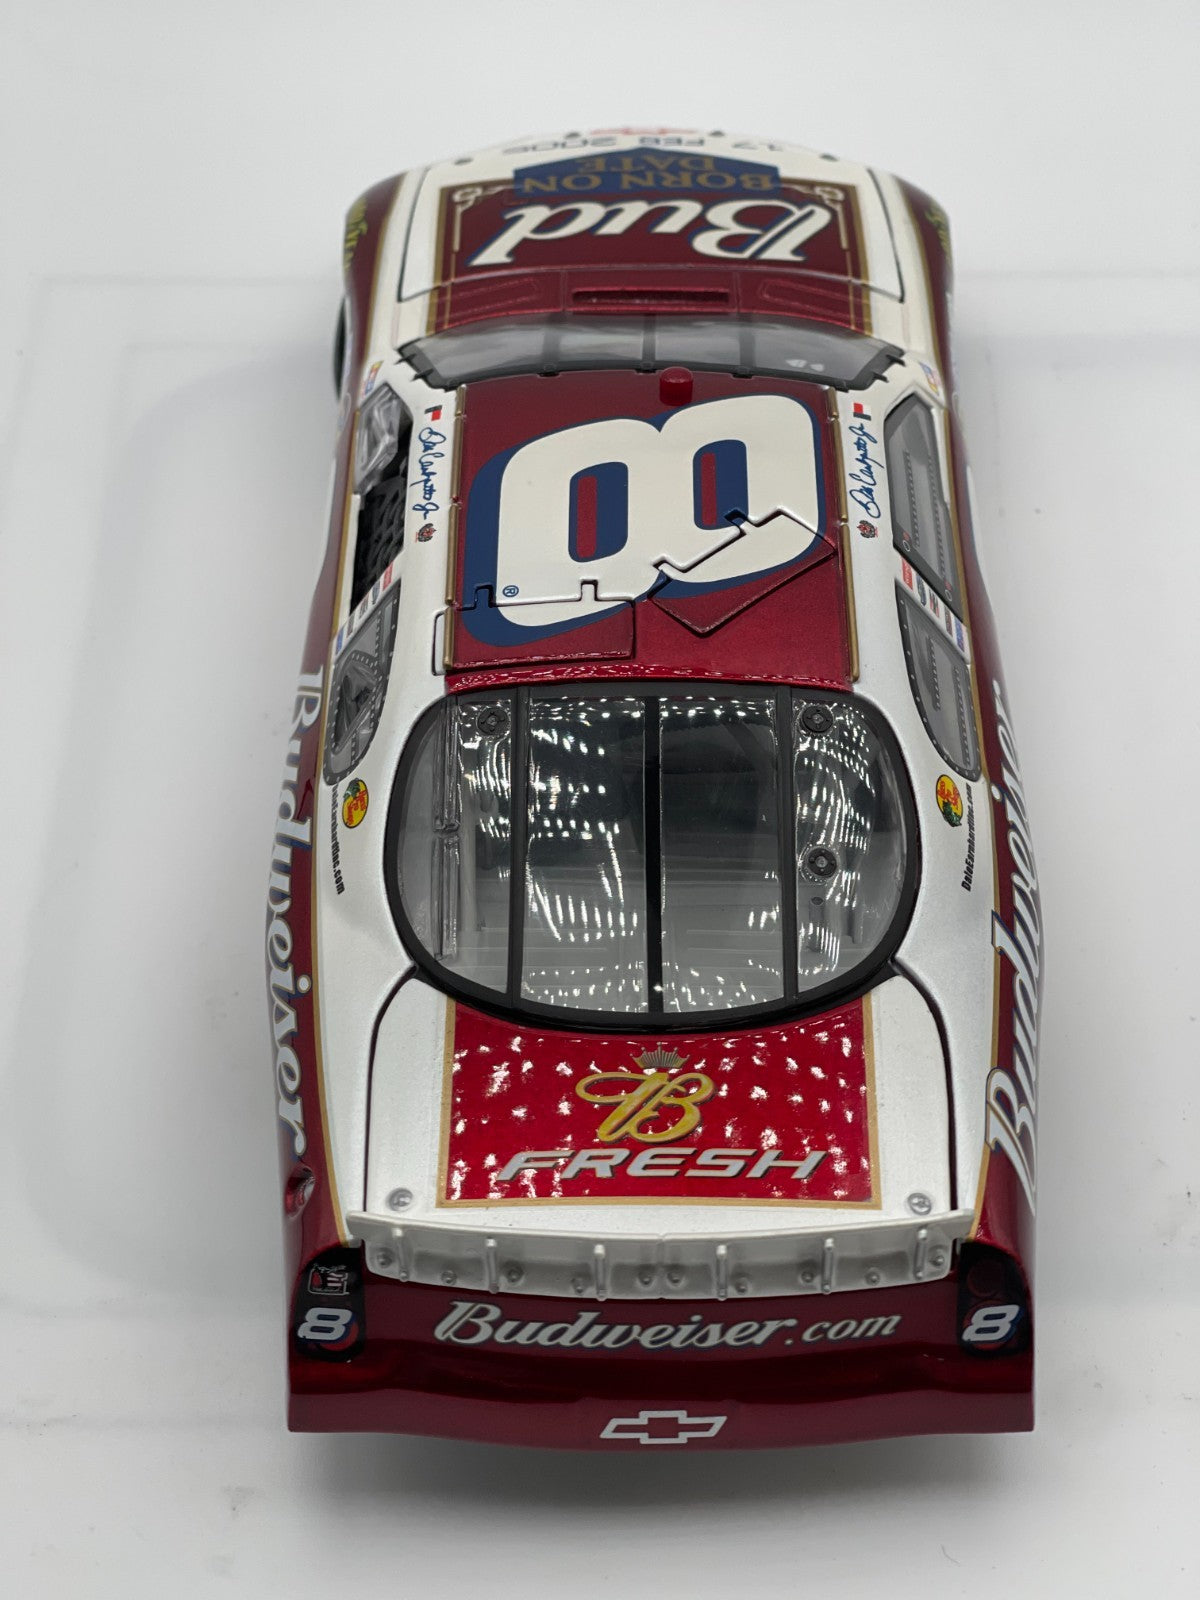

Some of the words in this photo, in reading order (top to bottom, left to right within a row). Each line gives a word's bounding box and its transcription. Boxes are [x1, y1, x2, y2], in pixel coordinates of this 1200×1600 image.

[638, 137, 705, 147] FEB
[576, 154, 717, 173] DATE
[620, 171, 775, 191] BORN
[522, 173, 602, 194] ON
[467, 199, 832, 267] Bud
[496, 394, 820, 628] 8
[267, 663, 324, 1157] Budweiser
[986, 680, 1040, 1217] Budweiser
[496, 1147, 831, 1181] FRESH
[297, 1307, 353, 1341] 8
[433, 1300, 902, 1349] Budweiser.com
[961, 1304, 1020, 1342] 8
